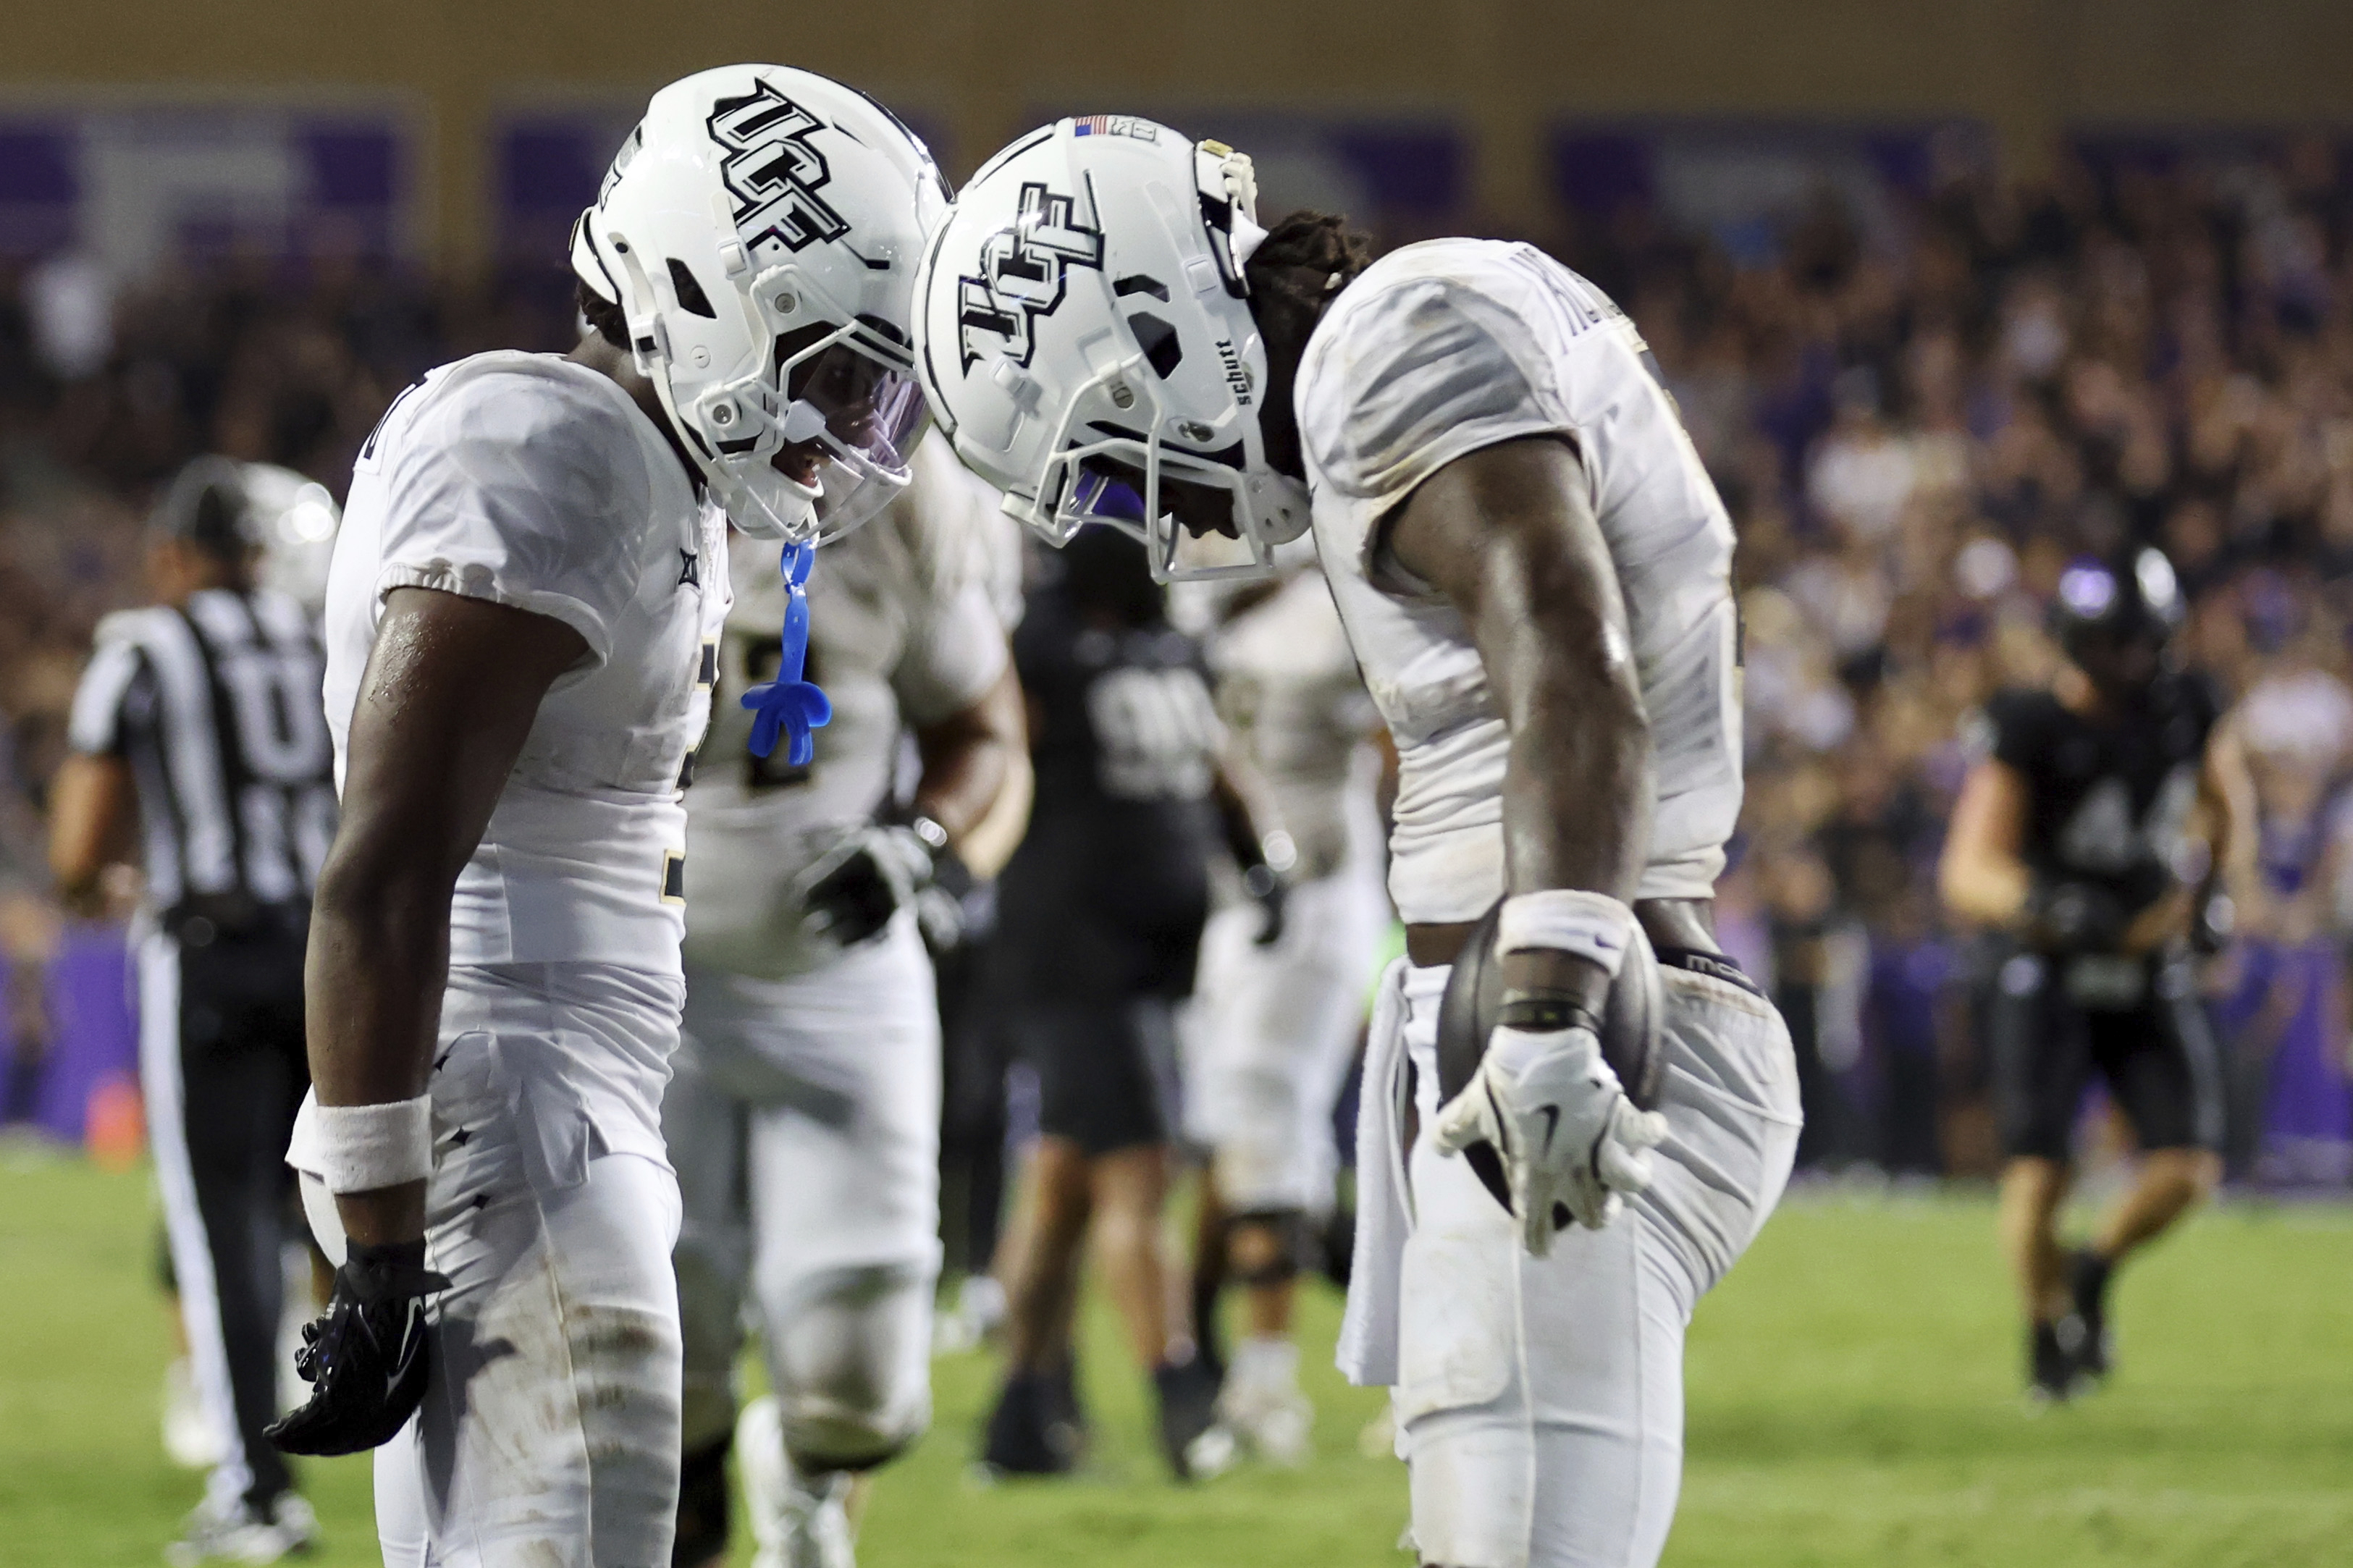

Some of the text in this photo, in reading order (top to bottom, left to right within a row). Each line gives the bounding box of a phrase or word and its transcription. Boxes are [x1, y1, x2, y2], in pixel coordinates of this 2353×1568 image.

[706, 77, 851, 253] UCF
[958, 182, 1105, 379] UCF
[1215, 337, 1252, 405] schutt
